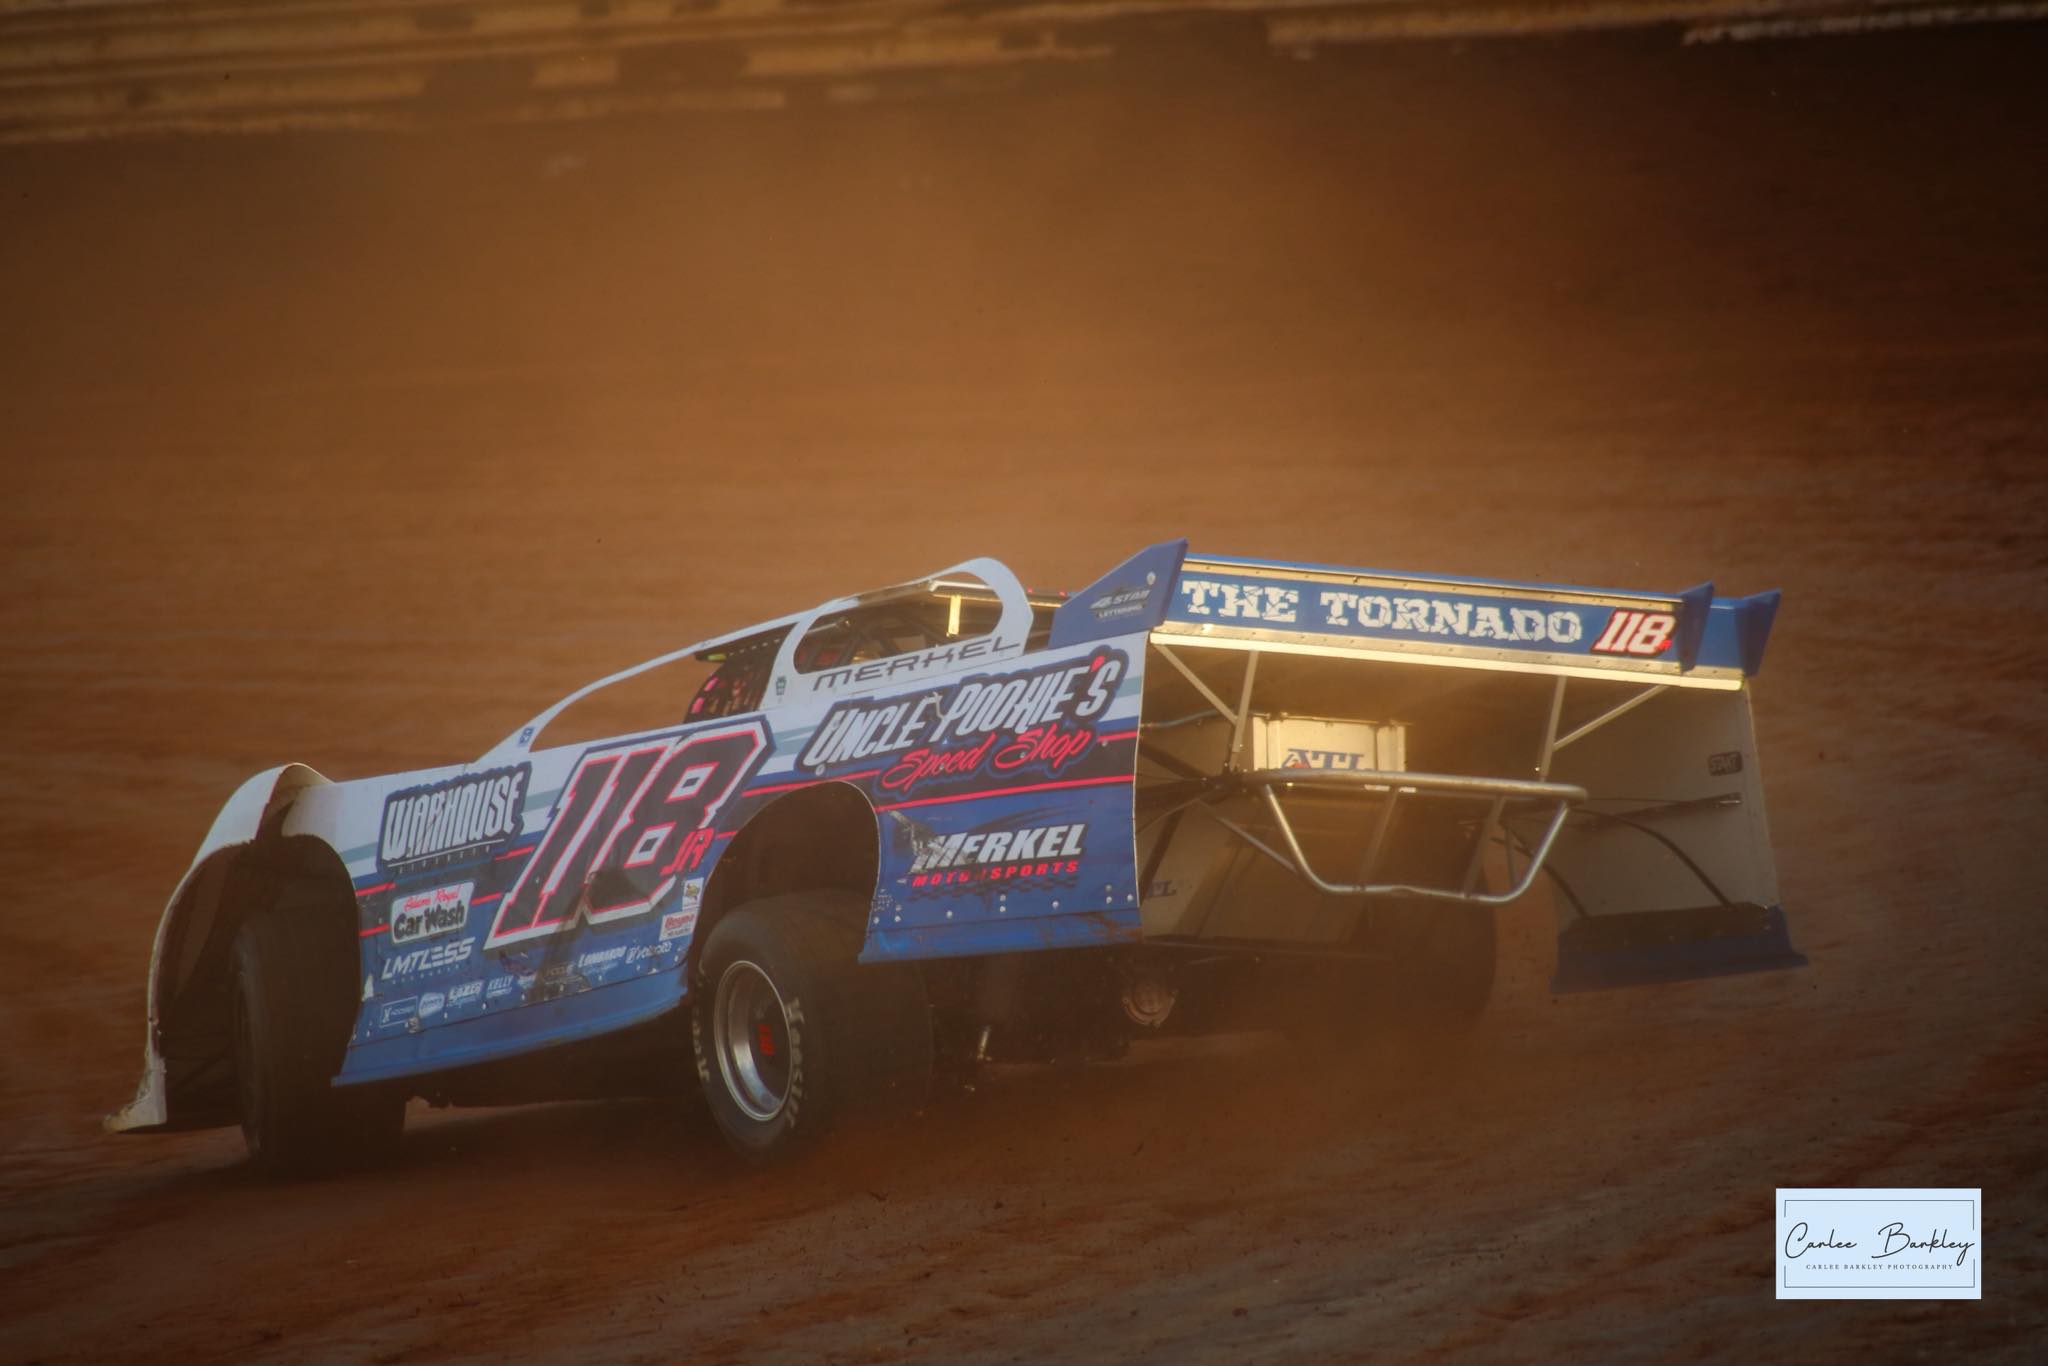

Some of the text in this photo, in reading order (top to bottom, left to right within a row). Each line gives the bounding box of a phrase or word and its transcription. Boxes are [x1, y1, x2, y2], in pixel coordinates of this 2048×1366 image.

[1181, 580, 1677, 654] THE TORNADO 118
[812, 635, 1023, 692] MERKEL
[803, 656, 1121, 766] UNCLE POOKIE'S
[881, 722, 1092, 792] Speed Shop
[660, 827, 714, 876] JR
[909, 823, 1085, 873] MERKEL
[394, 900, 465, 940] Car Wash
